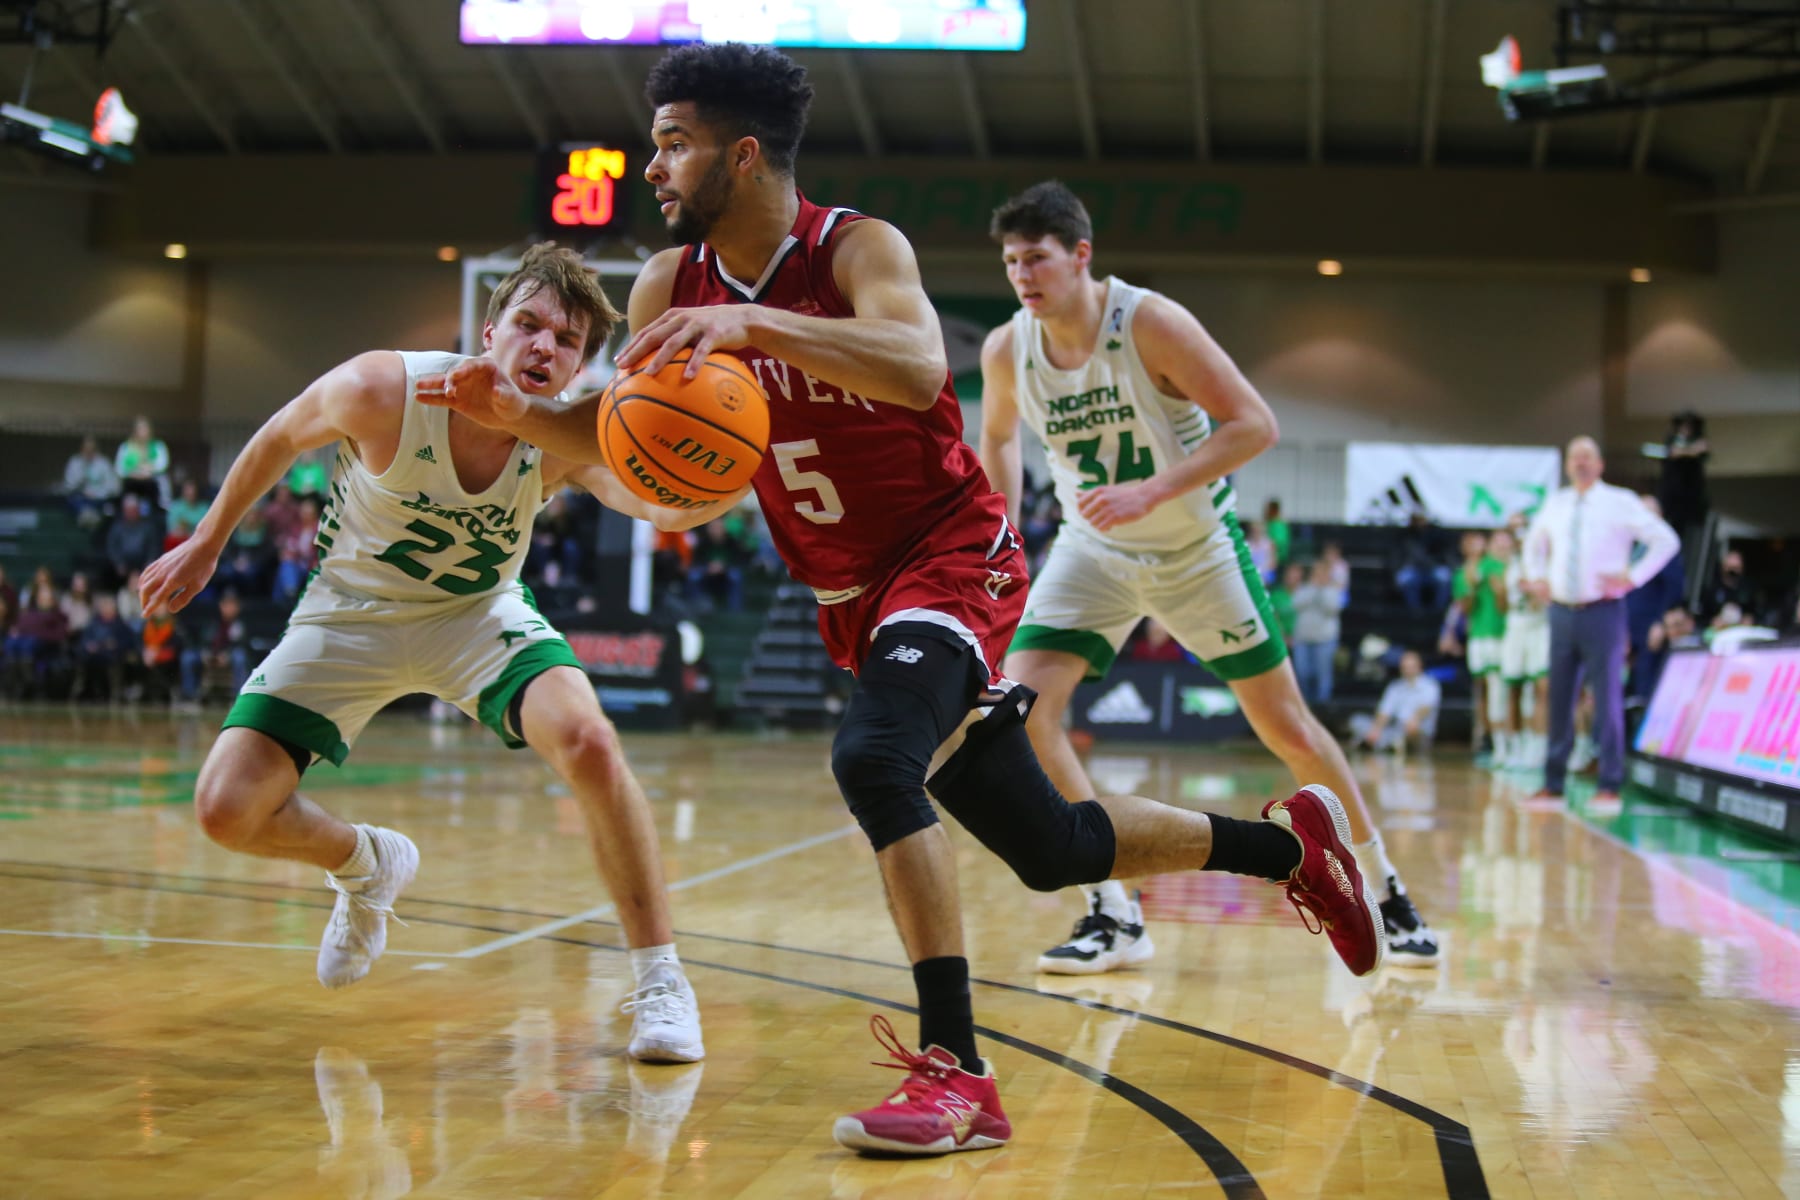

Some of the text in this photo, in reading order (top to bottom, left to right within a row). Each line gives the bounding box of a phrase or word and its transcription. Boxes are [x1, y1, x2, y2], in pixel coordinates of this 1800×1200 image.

[552, 173, 614, 225] 20
[1046, 385, 1119, 418] NORTH
[1046, 405, 1136, 435] DAKOTA
[770, 438, 846, 525] 5
[1066, 430, 1155, 490] 34
[373, 518, 516, 595] 23
